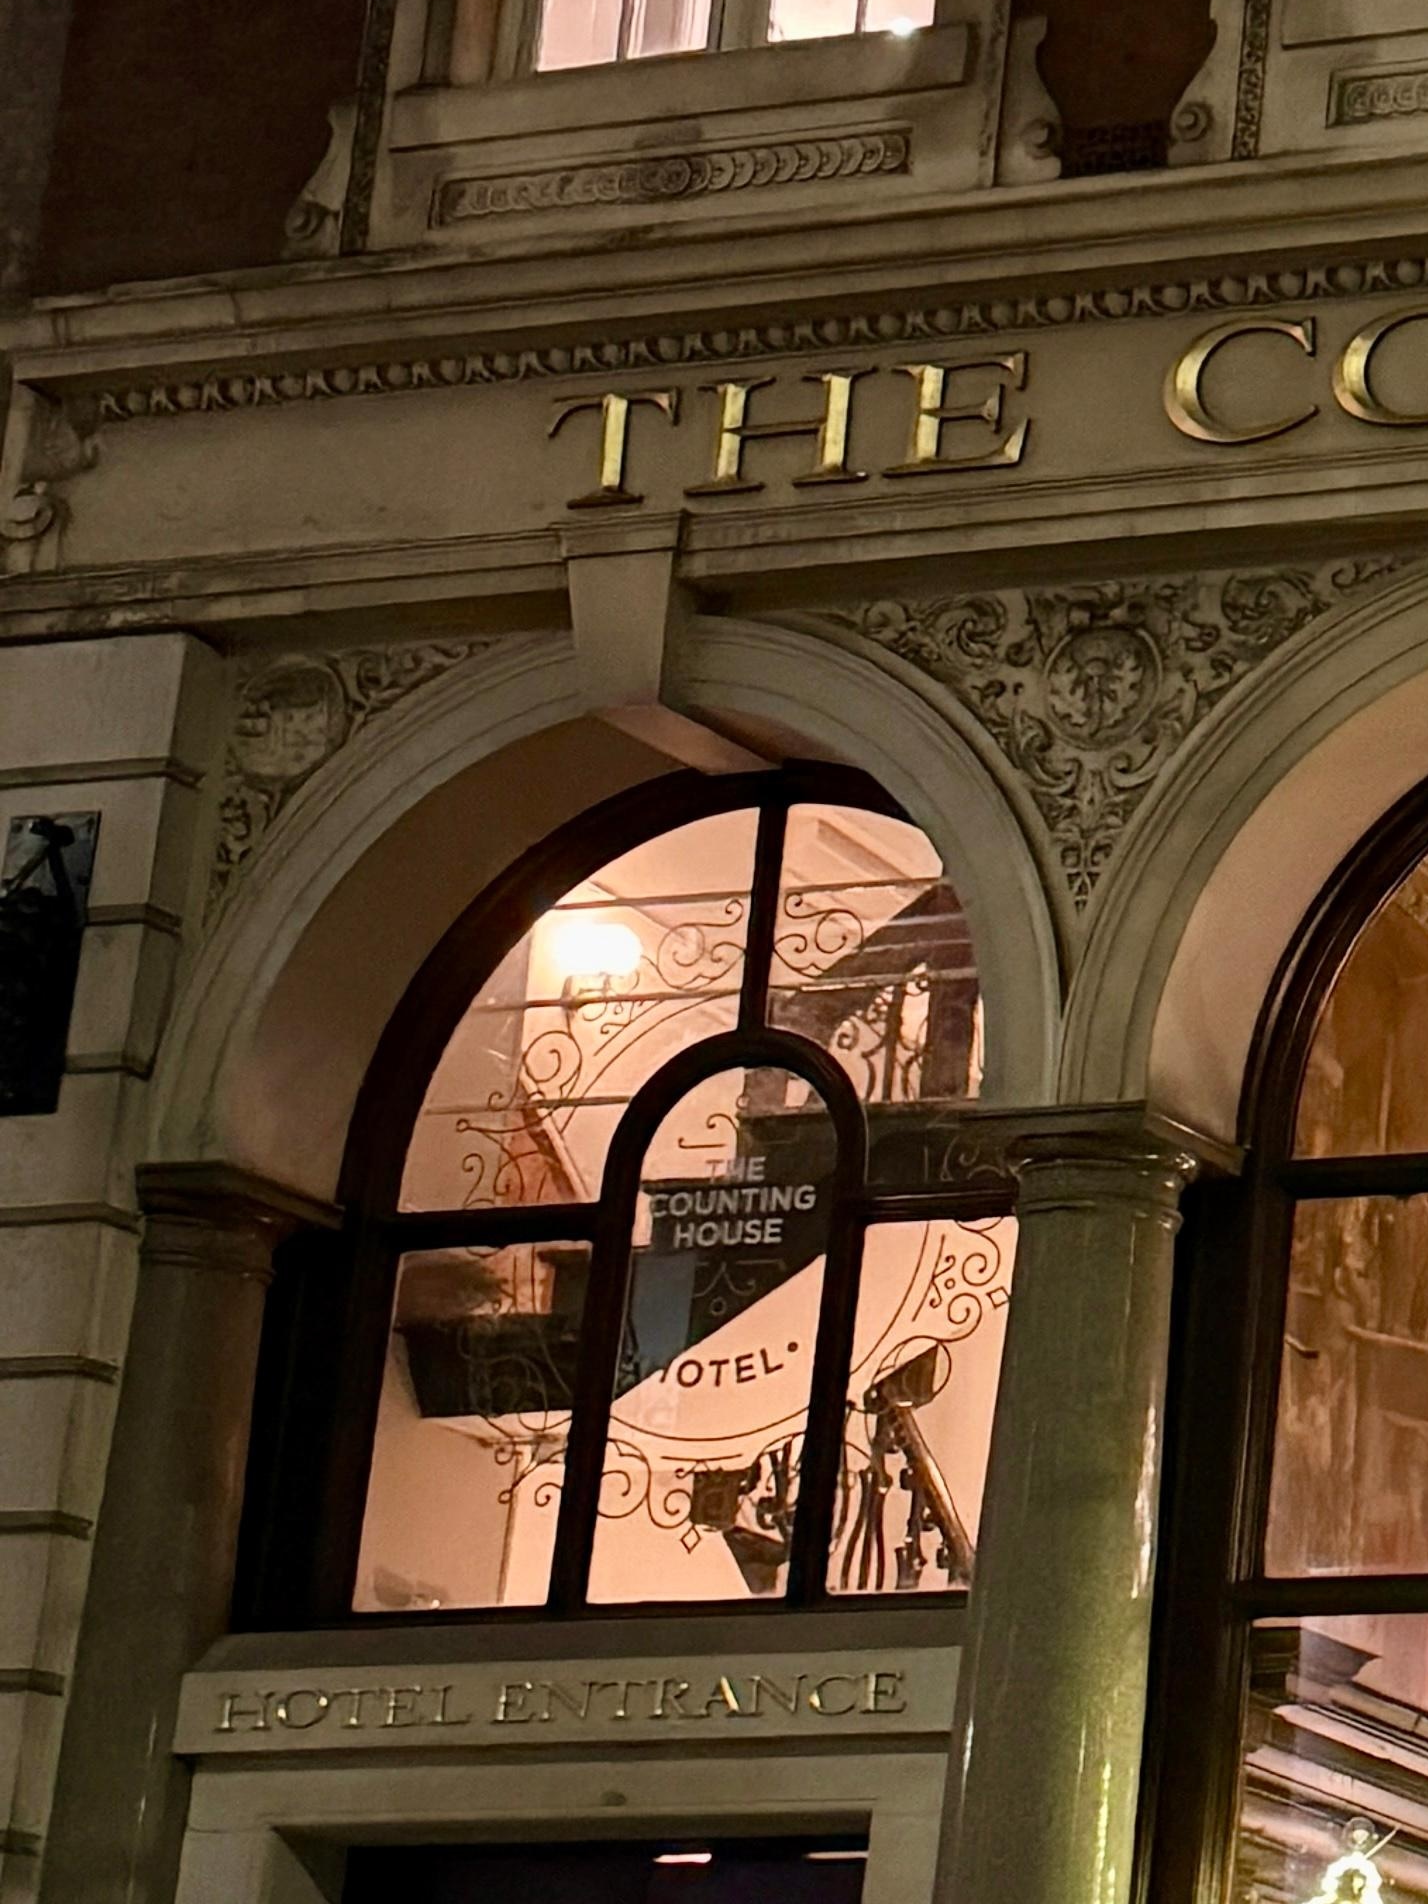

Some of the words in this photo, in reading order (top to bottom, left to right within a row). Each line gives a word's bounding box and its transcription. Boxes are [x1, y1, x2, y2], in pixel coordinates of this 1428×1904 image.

[548, 349, 1031, 509] THE
[705, 1155, 767, 1183] THE
[650, 1184, 818, 1219] COUNTING
[673, 1216, 784, 1249] HOUSE
[657, 1346, 785, 1389] OTEL
[212, 1683, 474, 1732] HOTEL
[488, 1671, 908, 1726] ENTRANCE
